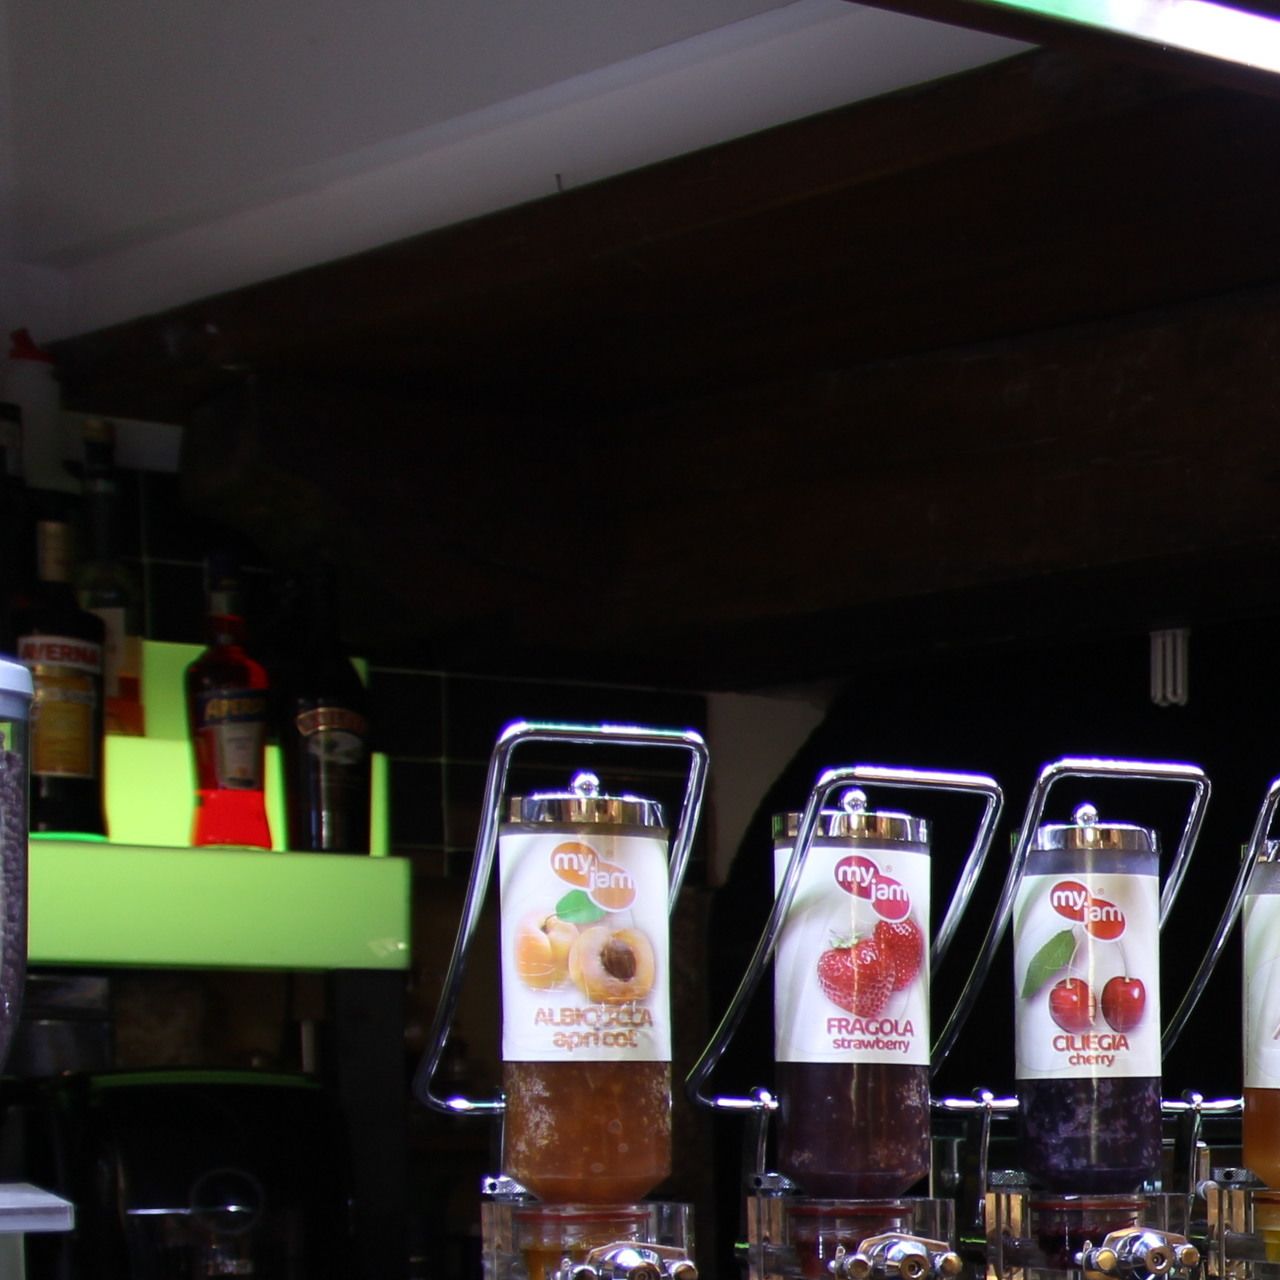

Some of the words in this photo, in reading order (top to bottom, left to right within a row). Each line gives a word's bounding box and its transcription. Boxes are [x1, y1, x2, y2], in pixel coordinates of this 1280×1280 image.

[553, 853, 593, 875] my
[589, 865, 634, 891] jam
[837, 865, 875, 888] my
[871, 877, 908, 903] jam
[1052, 890, 1086, 911] my
[1083, 901, 1122, 924] jam
[827, 1018, 914, 1037] FRAGOLA
[832, 1036, 911, 1054] strawberry
[1053, 1034, 1129, 1052] CILIEGIA
[1068, 1052, 1116, 1068] cherry
